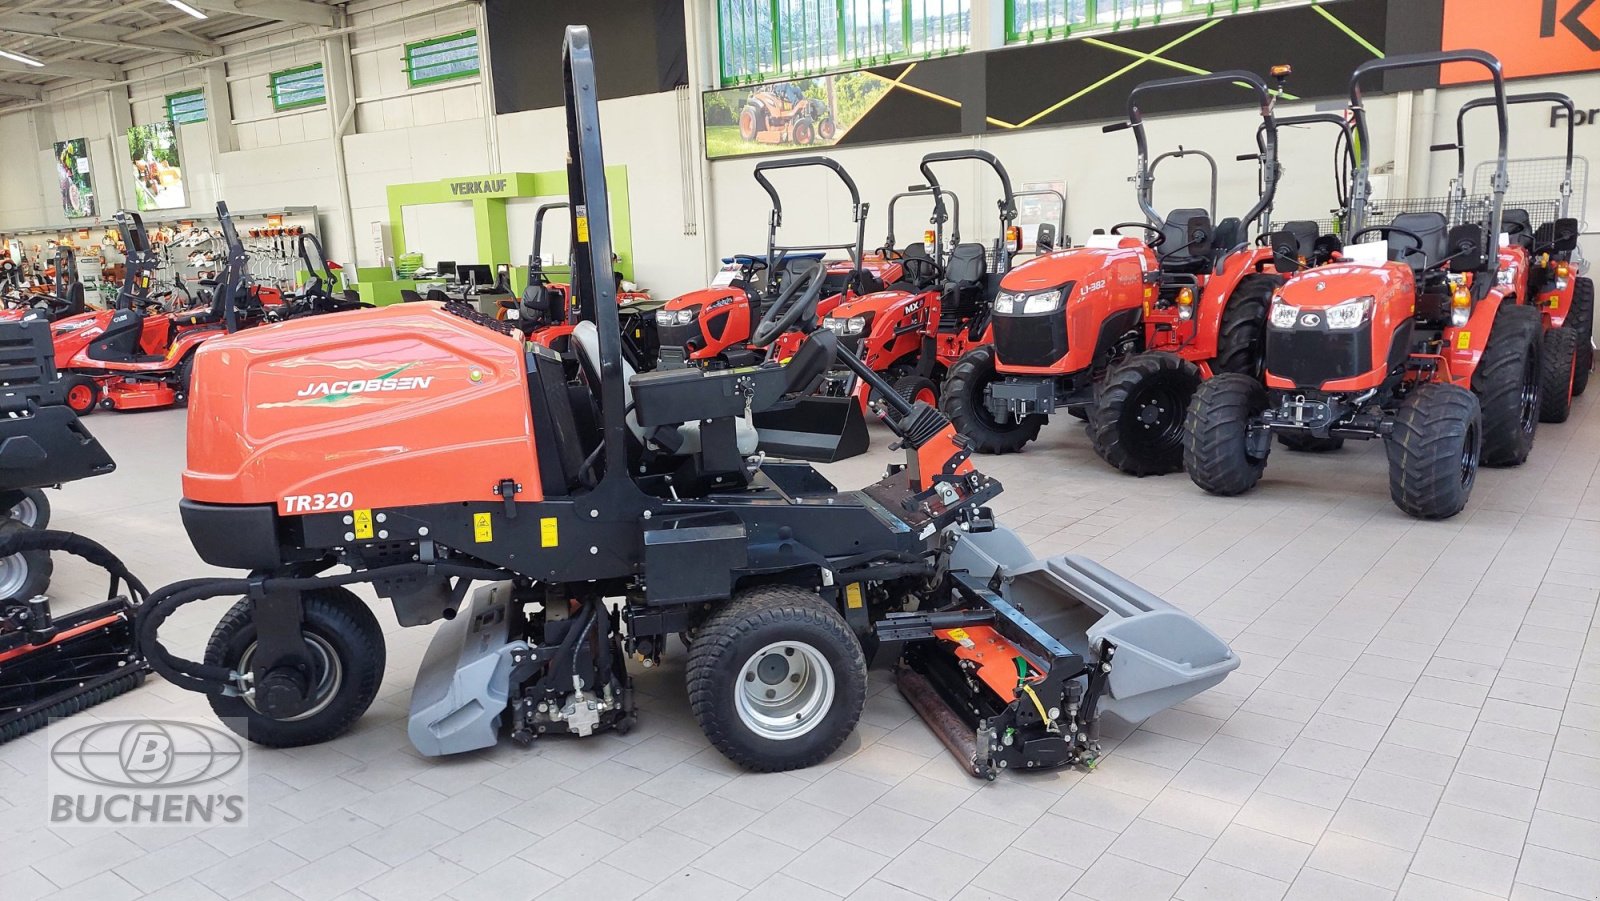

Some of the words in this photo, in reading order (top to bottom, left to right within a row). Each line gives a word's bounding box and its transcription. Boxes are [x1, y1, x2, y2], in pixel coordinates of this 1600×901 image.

[450, 179, 507, 195] VERKAUF
[298, 376, 434, 396] JACOBSEN
[283, 491, 354, 513] TR320
